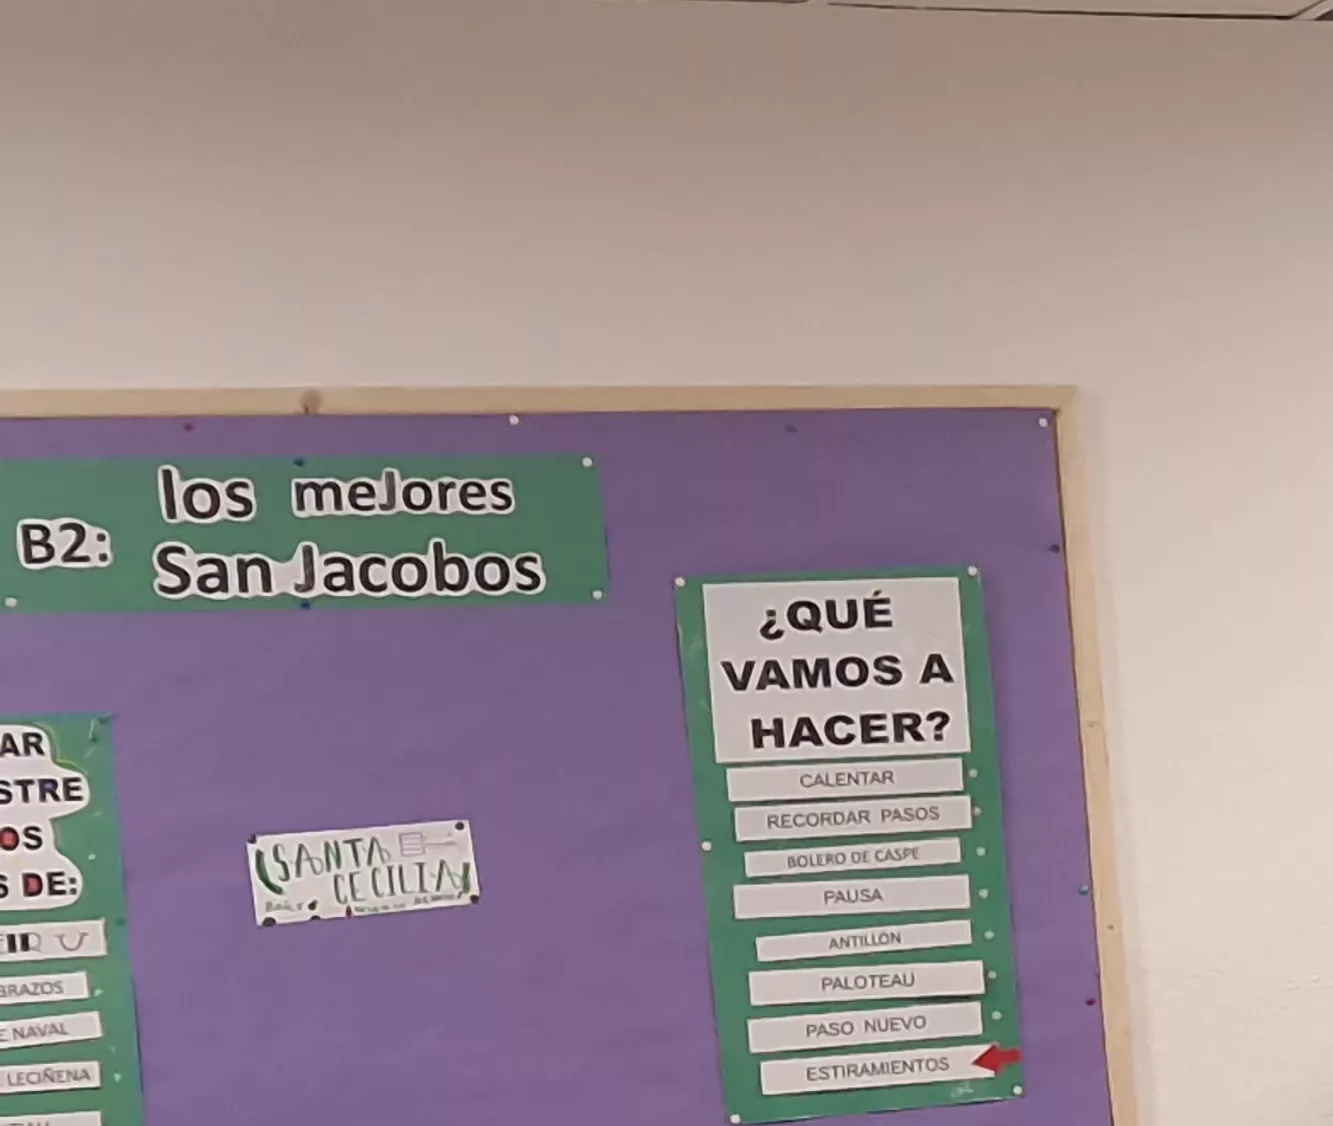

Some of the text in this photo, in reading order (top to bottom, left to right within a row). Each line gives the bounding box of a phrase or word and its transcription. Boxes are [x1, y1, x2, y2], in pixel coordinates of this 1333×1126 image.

[161, 468, 255, 520] los
[20, 521, 110, 565] B2:
[155, 540, 544, 595] San Jacobos
[759, 590, 893, 640] ¿QUÉ
[720, 653, 955, 692] VAMOS A
[750, 710, 951, 750] HACER?
[799, 770, 896, 789] CALENTAR
[766, 805, 941, 829] RECORDAR PASOS
[271, 836, 393, 882] SANTA
[786, 846, 921, 869] BOLERO DE CASPE
[22, 871, 78, 897] DE:
[333, 858, 463, 905] CECILIA
[823, 887, 884, 905] PAUSA
[820, 971, 916, 992] PALOTEAU
[12, 1022, 69, 1041] NAVAL
[805, 1014, 927, 1039] PASO NUEVO
[805, 1055, 951, 1082] ESTIRAMIENTOS
